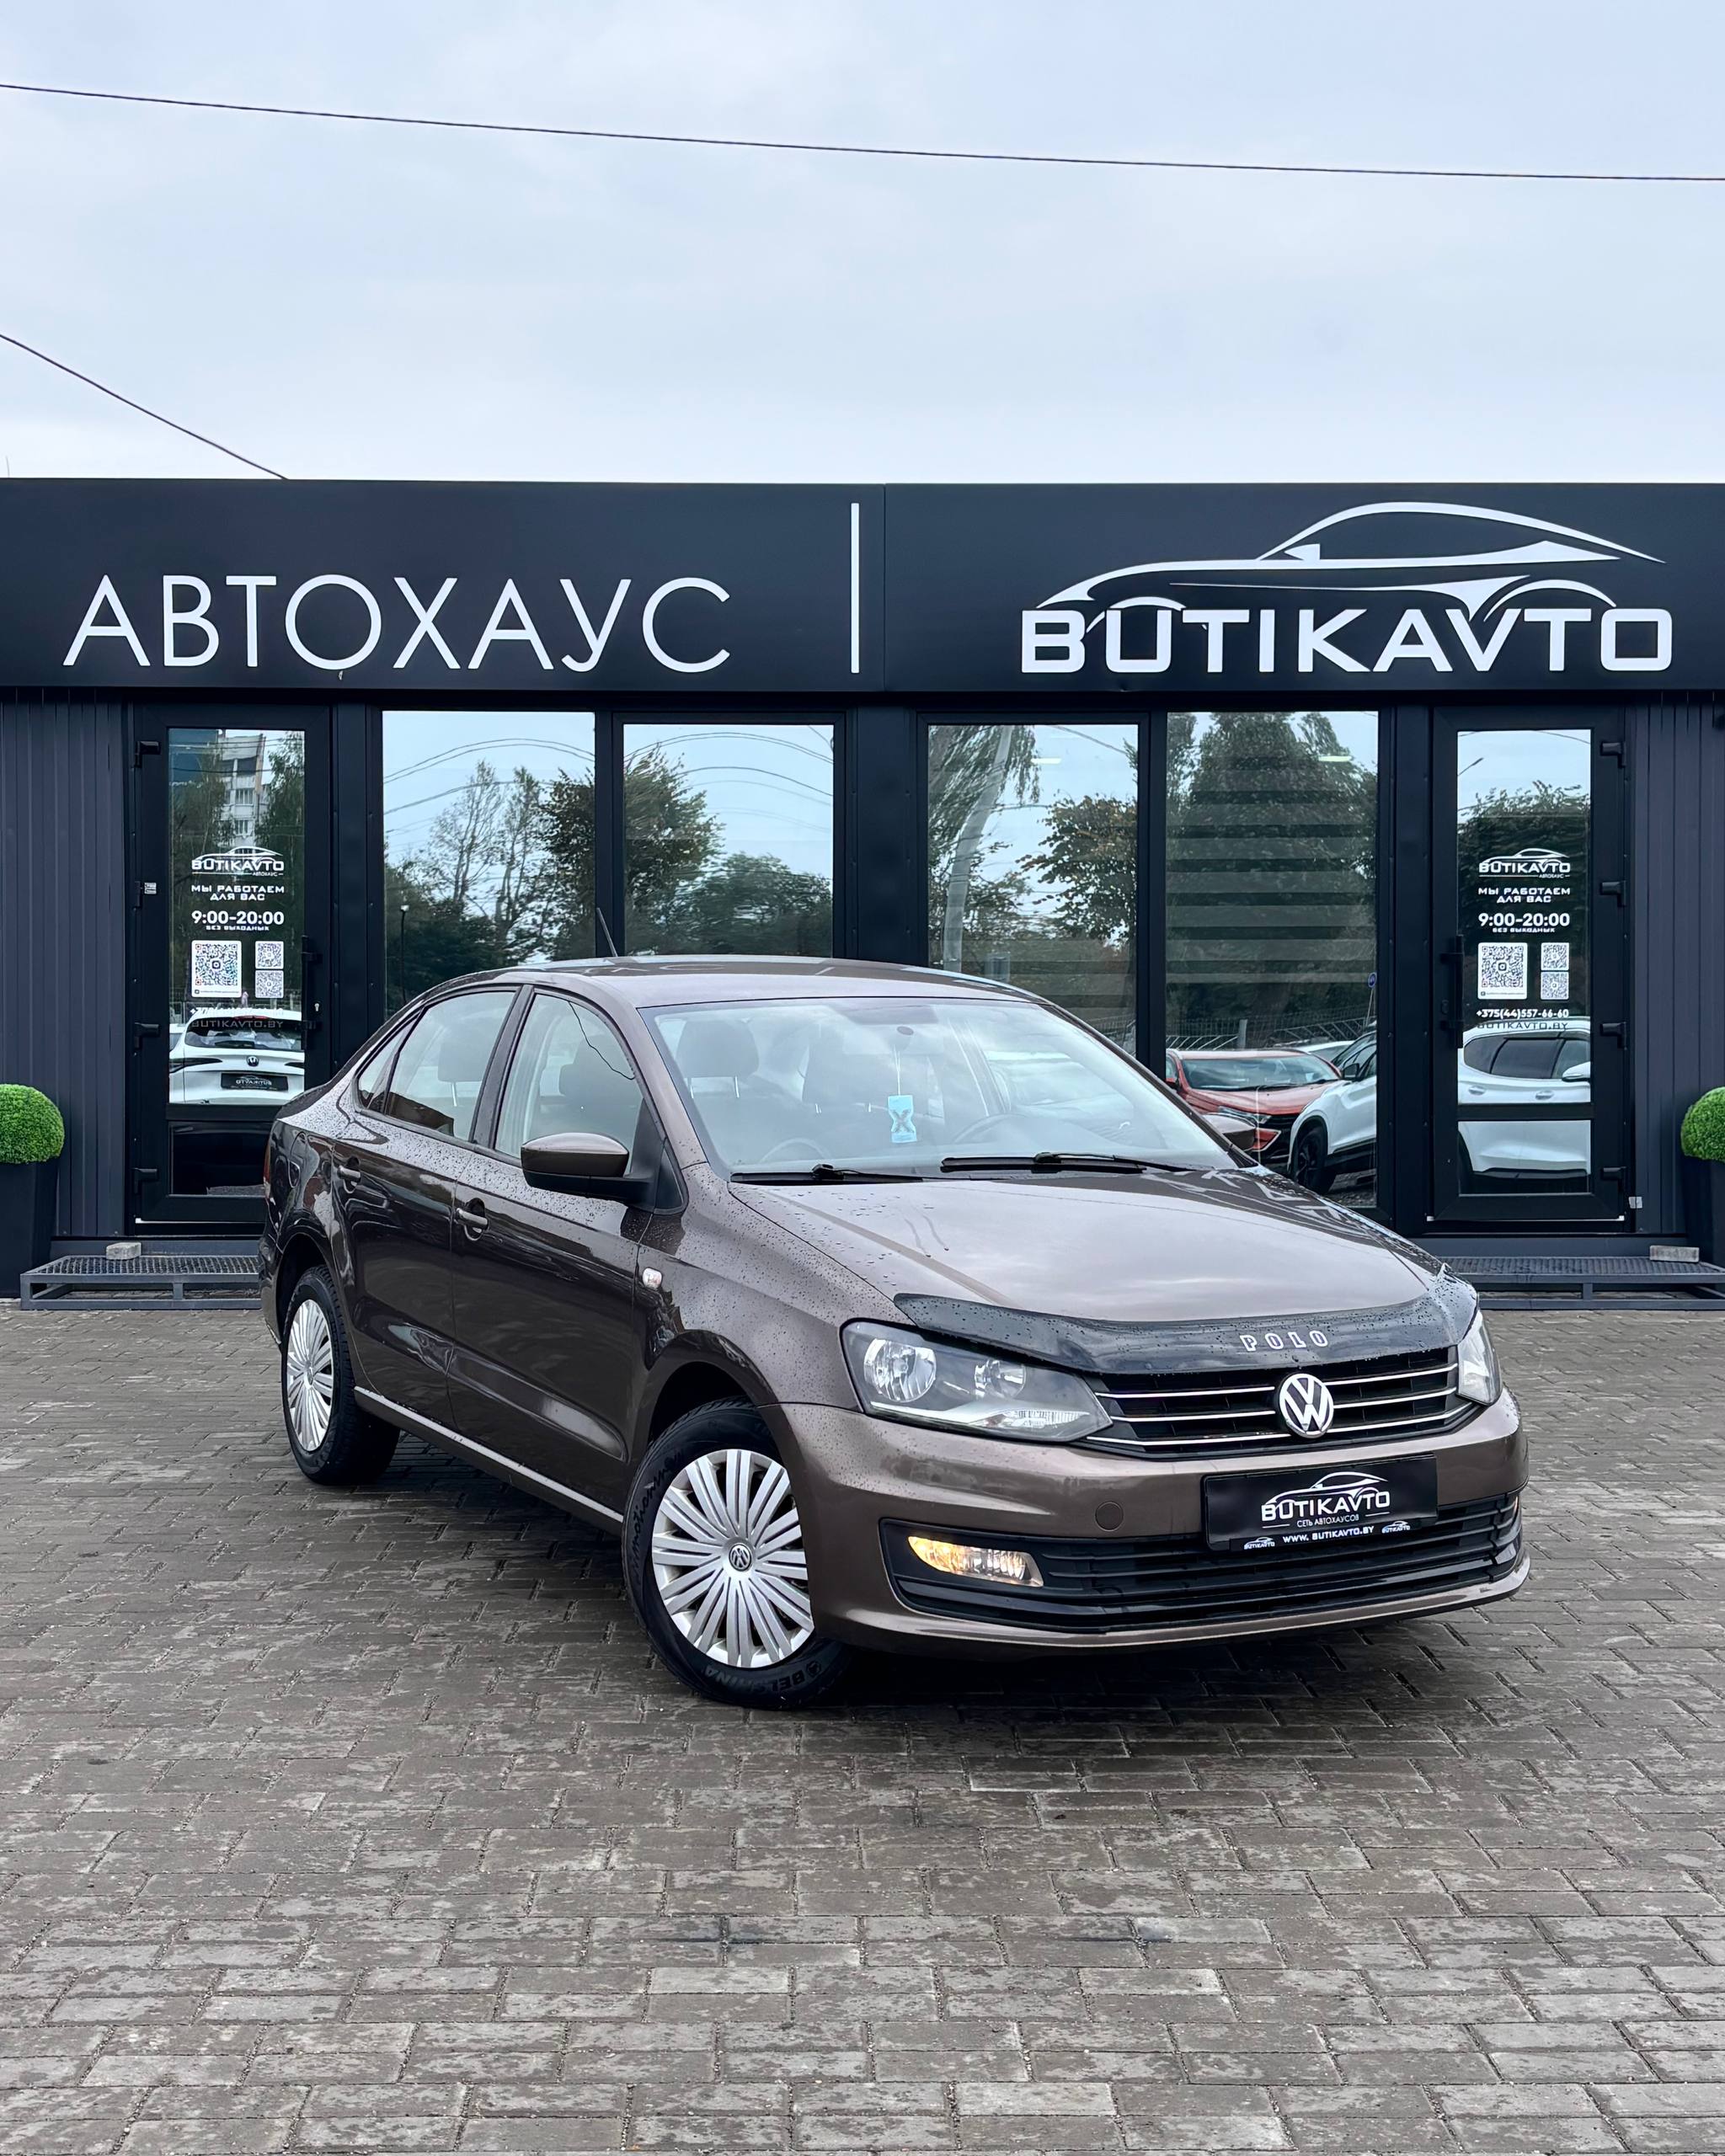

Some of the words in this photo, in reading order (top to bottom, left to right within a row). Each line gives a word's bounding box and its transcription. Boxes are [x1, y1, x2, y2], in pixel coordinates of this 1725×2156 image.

[62, 574, 730, 673] АВТОХАУС
[1020, 607, 1673, 673] BUTIKAVTO
[191, 859, 285, 871] BUTIKAVTO
[1478, 862, 1571, 873] BUTIKAVTO
[210, 893, 235, 901] ДЛЯ
[1497, 895, 1521, 904] ДЛЯ
[191, 910, 285, 925] 9:00-20:00
[1478, 913, 1571, 926] 9:00-20:00
[1239, 1330, 1328, 1352] POLO
[1261, 1492, 1390, 1522] BUTIKAVTO
[1297, 1519, 1313, 1528] СЕТЬ
[1314, 1514, 1359, 1526] АВТОХАУСОВ
[1283, 1534, 1309, 1543] WWW.
[1311, 1526, 1374, 1541] BUTIKAVTO.BY
